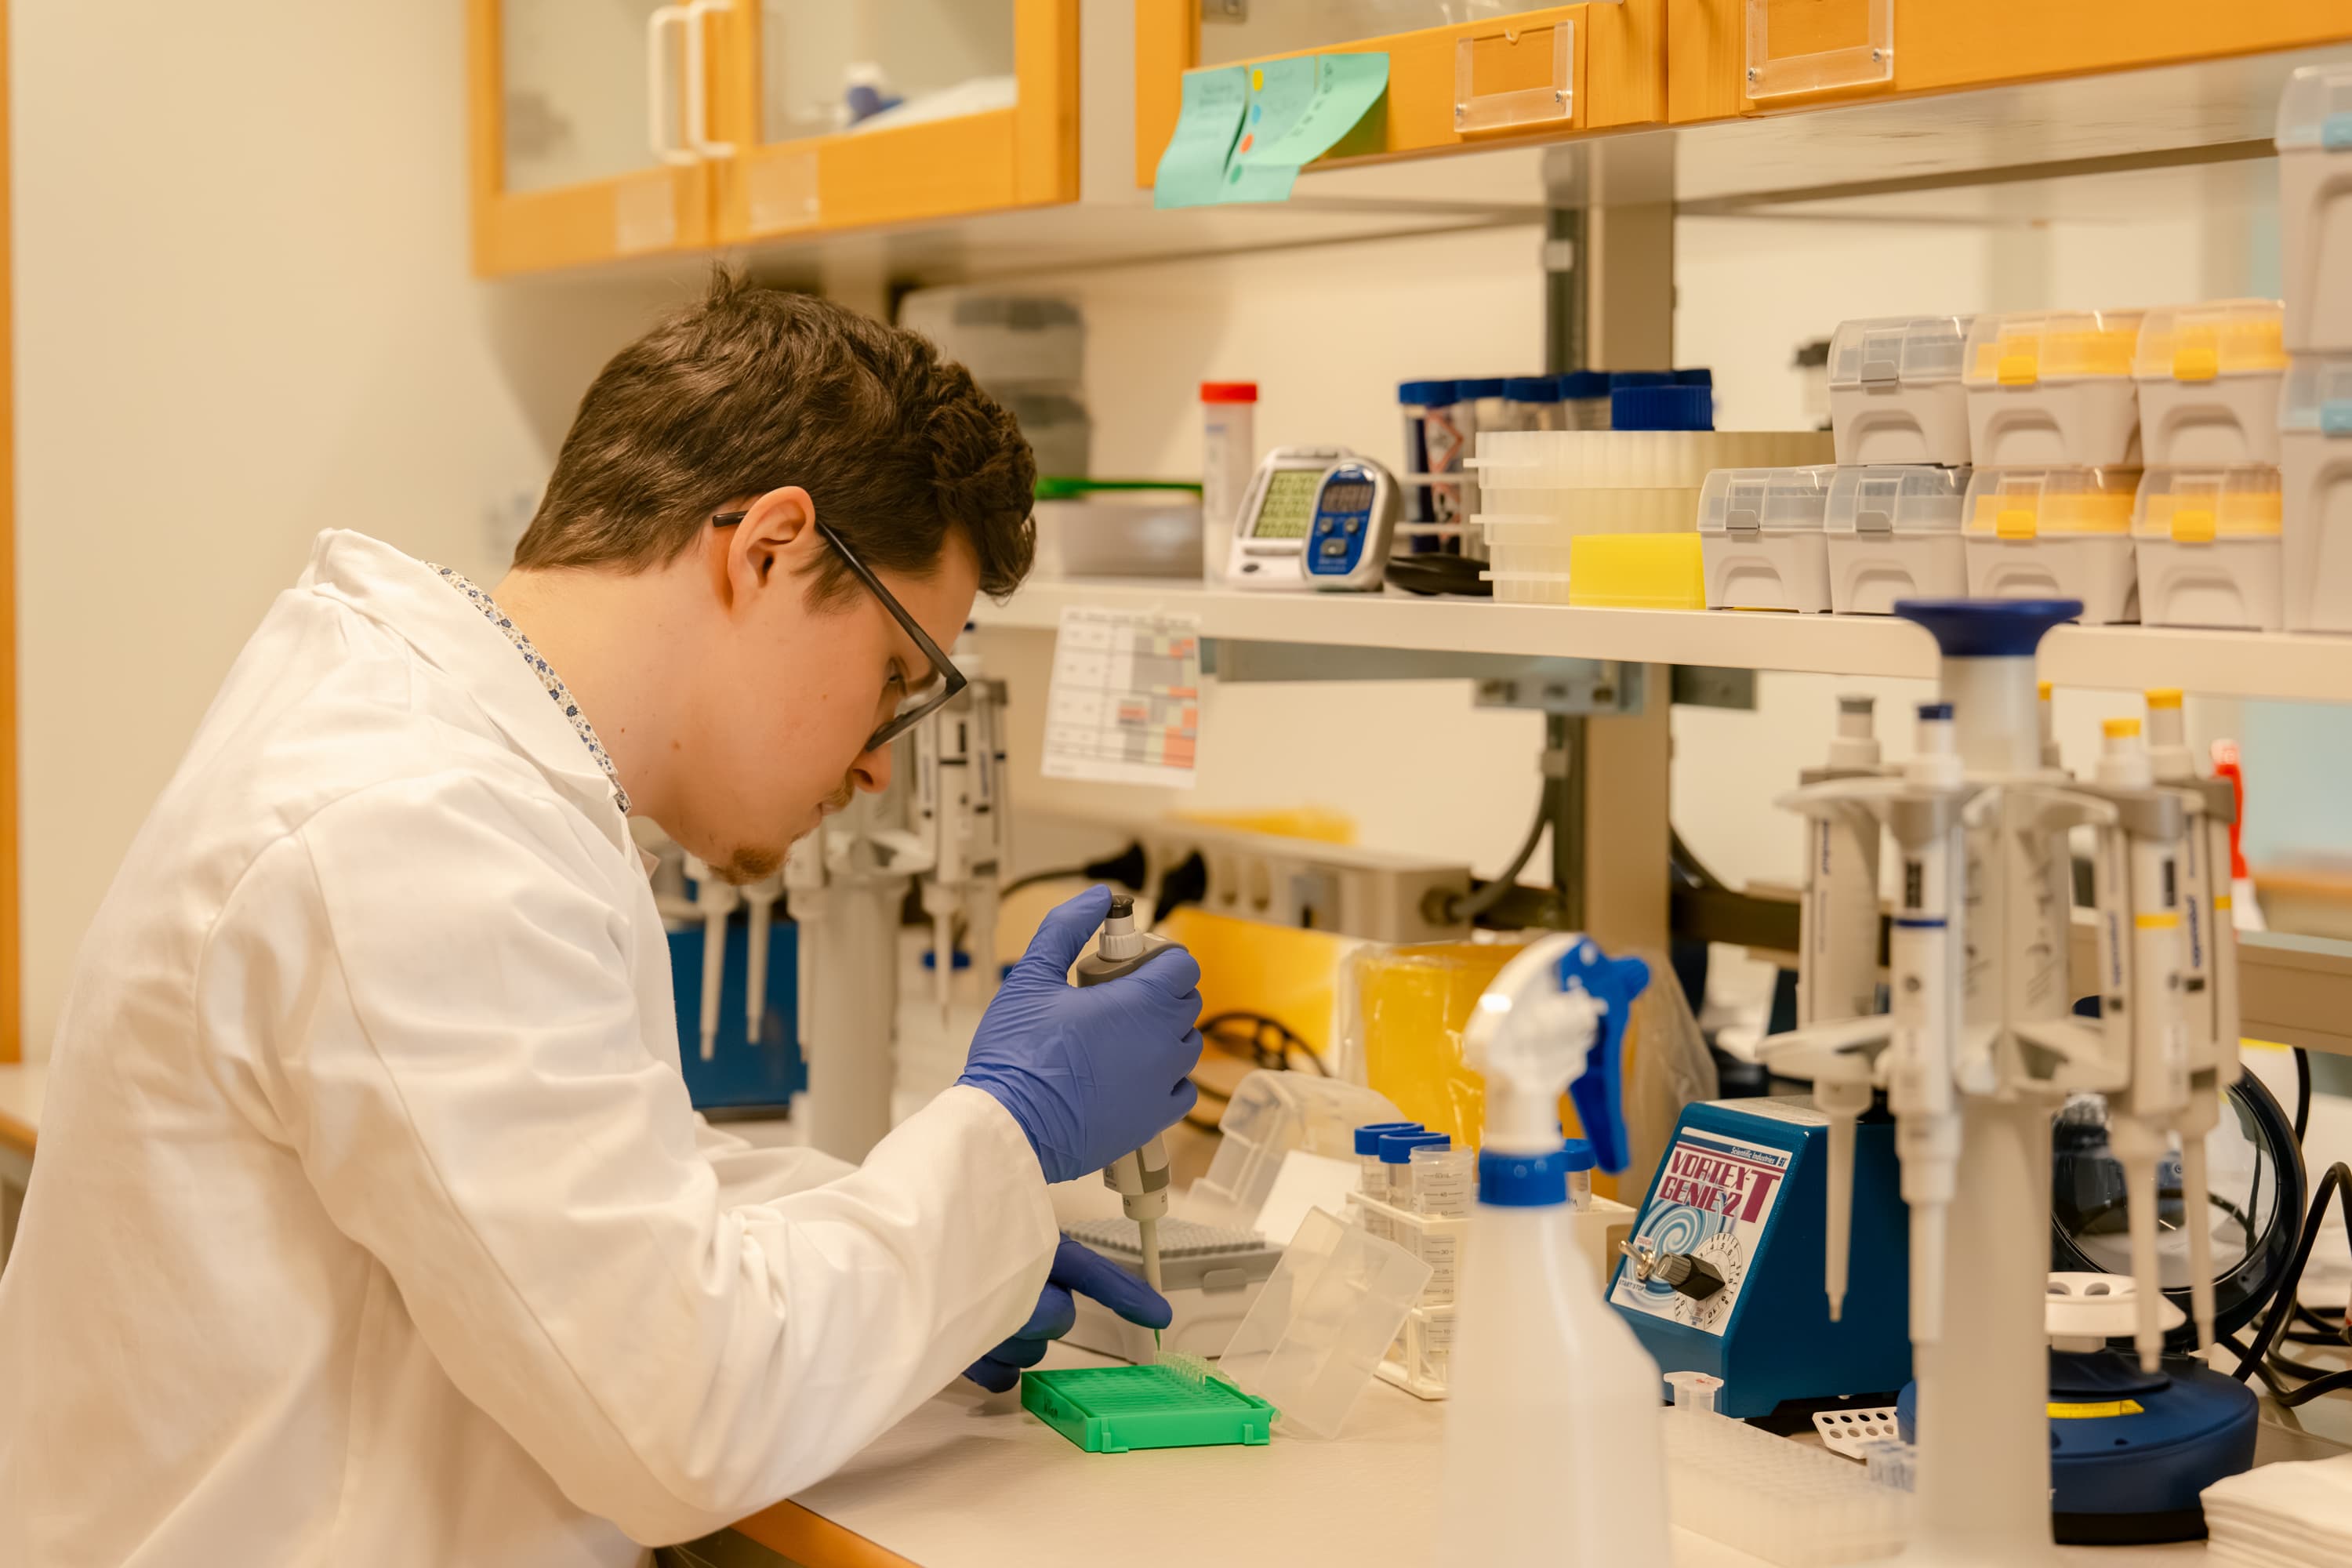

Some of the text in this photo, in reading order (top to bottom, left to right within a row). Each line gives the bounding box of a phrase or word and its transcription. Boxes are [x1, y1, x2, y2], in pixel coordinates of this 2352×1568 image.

[1730, 1146, 1753, 1159] Scientific
[1752, 1152, 1776, 1164] Industries
[1659, 1175, 1743, 1218] GENIE 2
[1740, 1169, 1782, 1224] T
